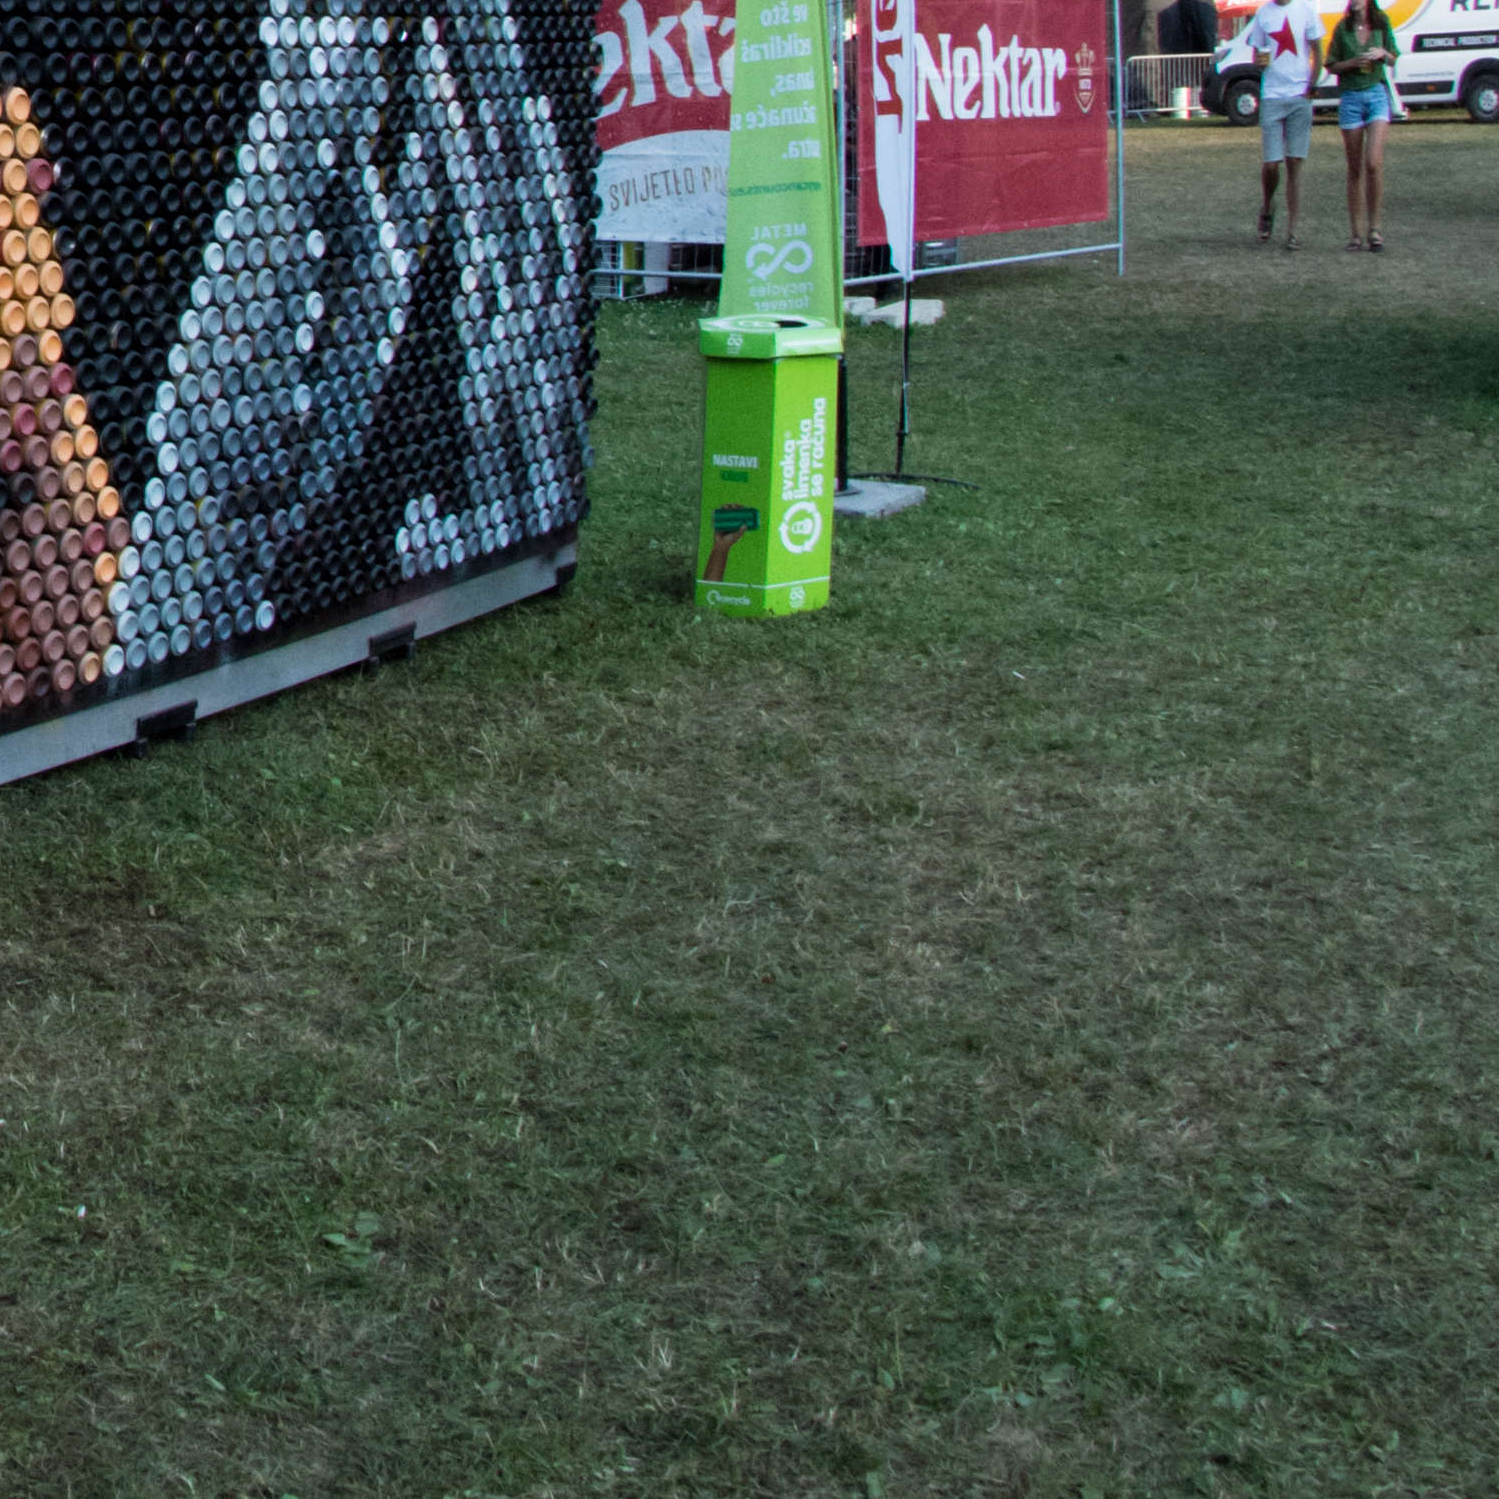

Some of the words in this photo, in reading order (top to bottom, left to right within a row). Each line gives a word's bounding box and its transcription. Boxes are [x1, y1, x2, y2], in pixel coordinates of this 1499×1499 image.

[915, 24, 1066, 121] Nektar
[609, 167, 695, 211] SVIJETLO
[712, 453, 758, 469] NASTAVI
[794, 419, 812, 499] limenka
[809, 397, 827, 470] računa
[782, 439, 795, 501] svaka
[810, 473, 824, 498] se
